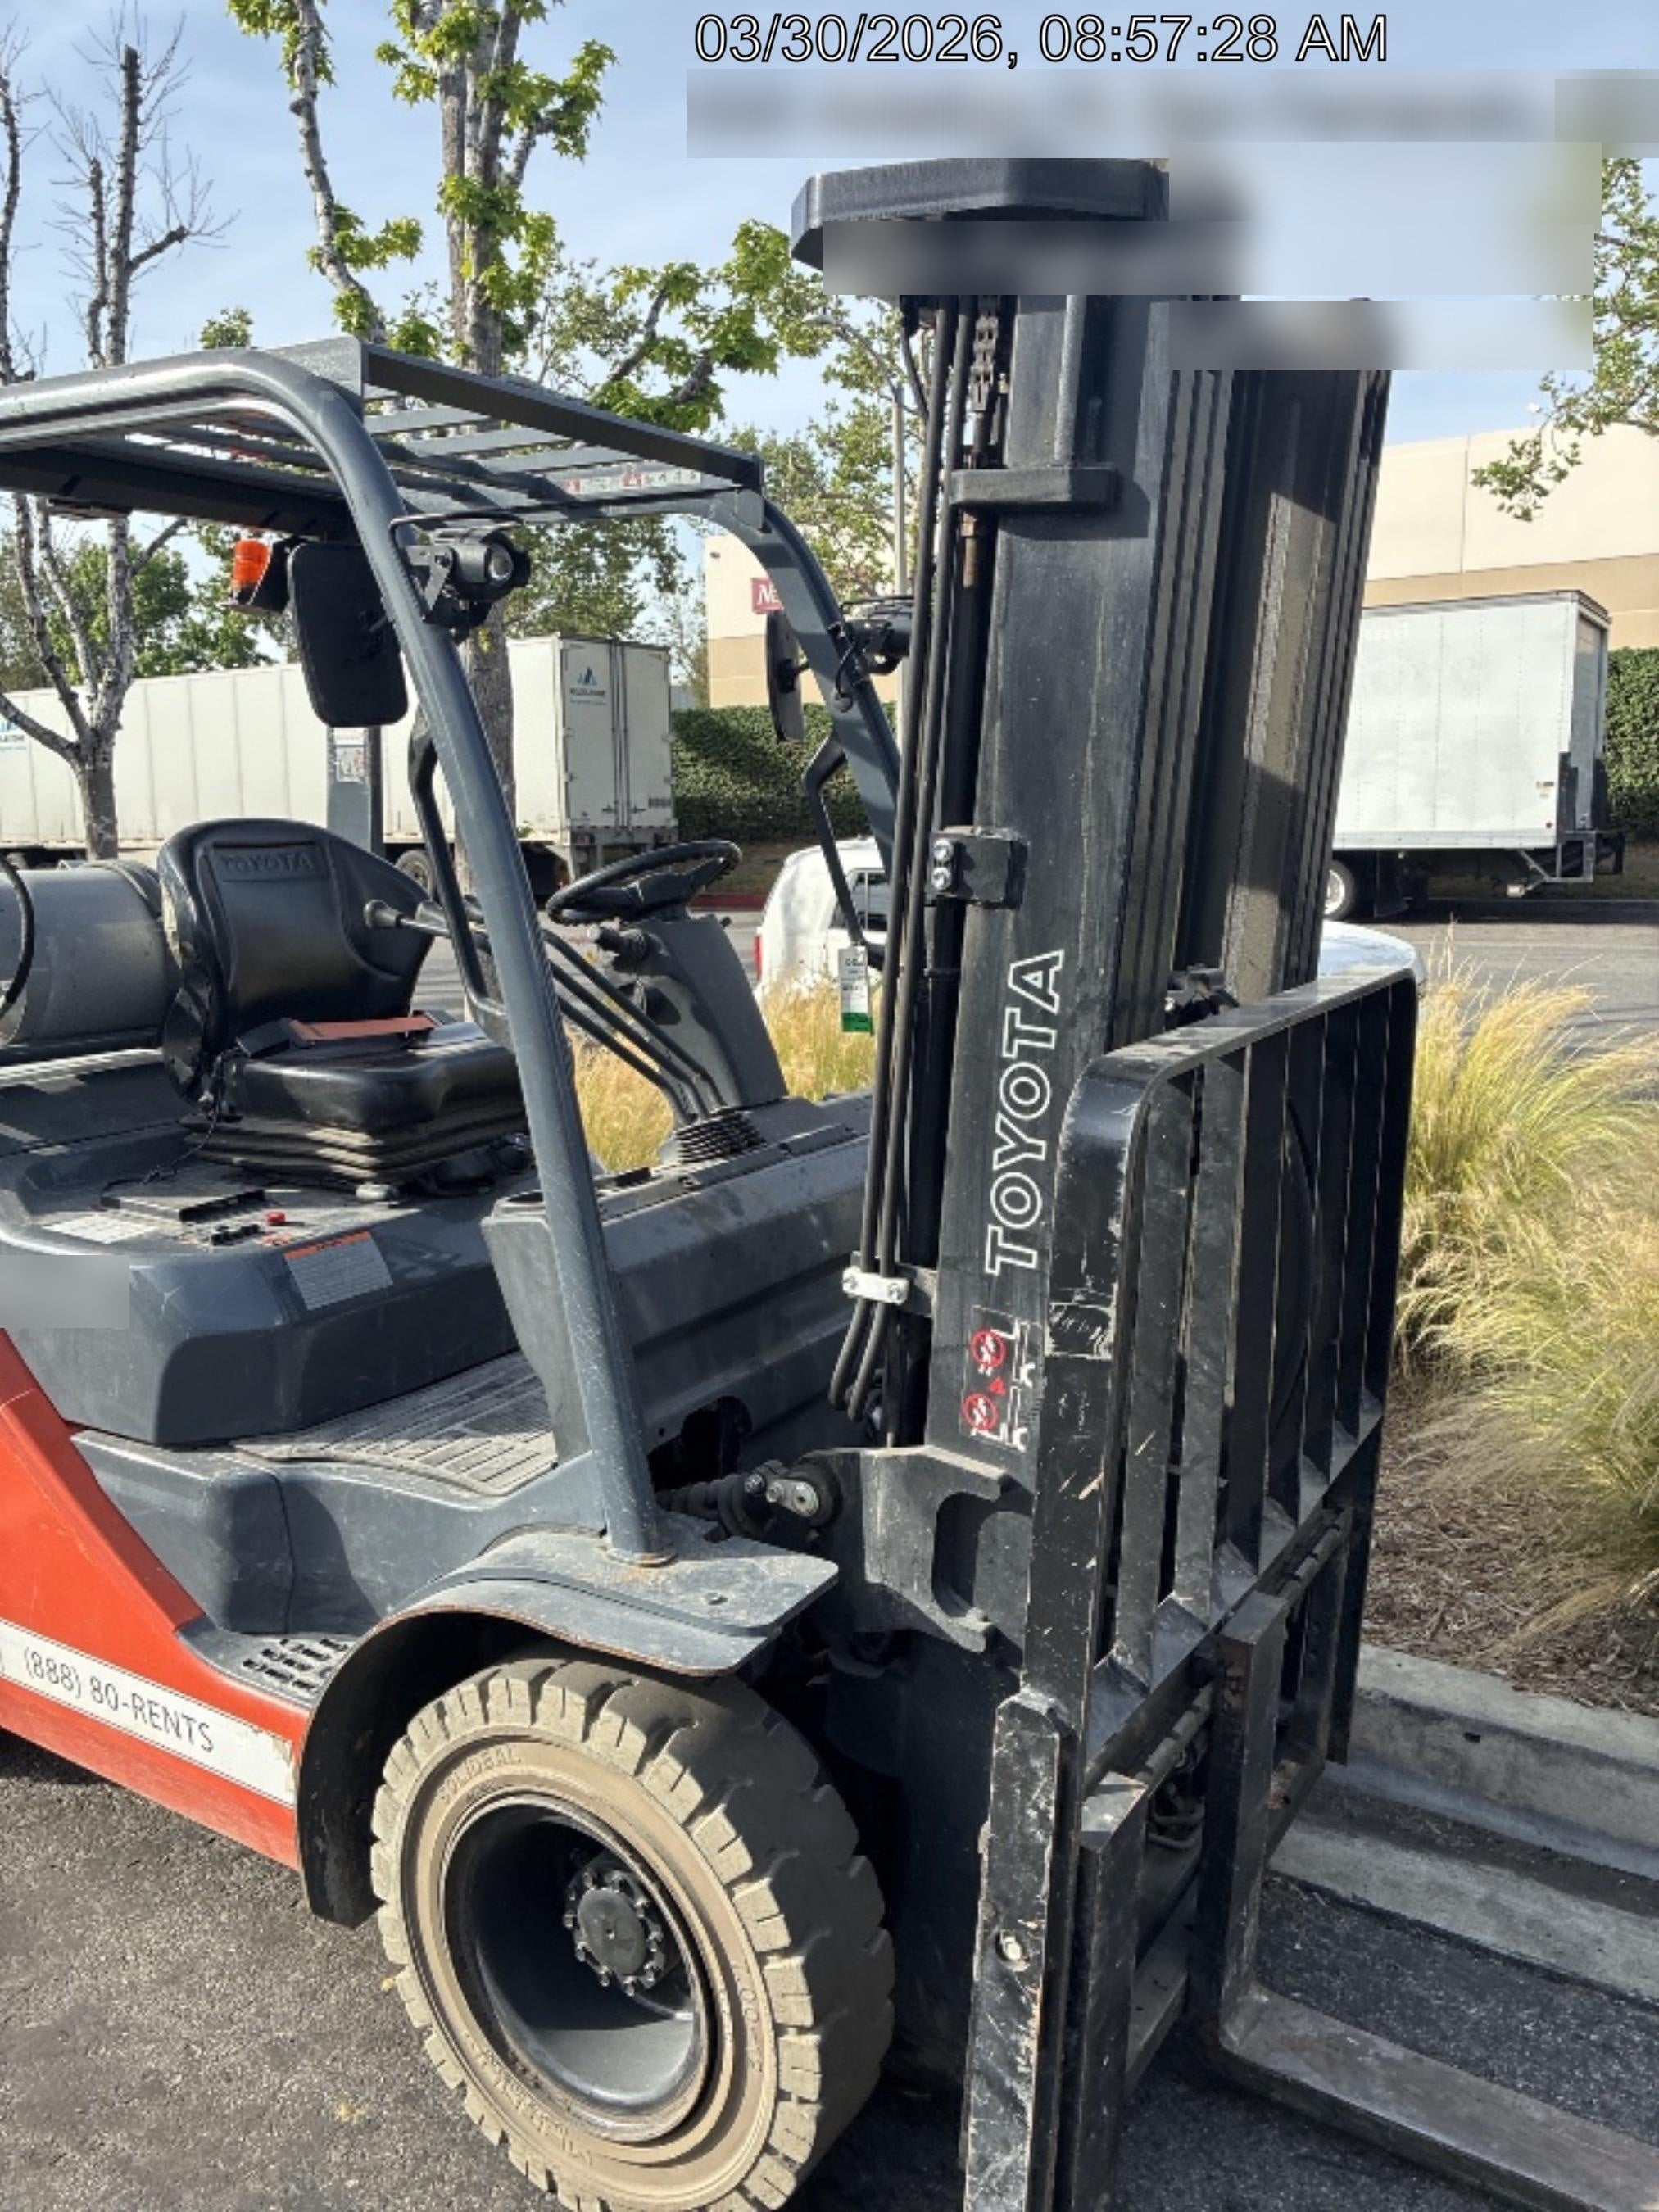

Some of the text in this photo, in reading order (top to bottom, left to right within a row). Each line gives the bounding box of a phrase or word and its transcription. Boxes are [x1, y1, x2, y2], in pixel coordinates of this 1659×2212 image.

[985, 948, 1065, 1276] TOYOTA
[24, 1646, 215, 1753] (888) 80-RENTS
